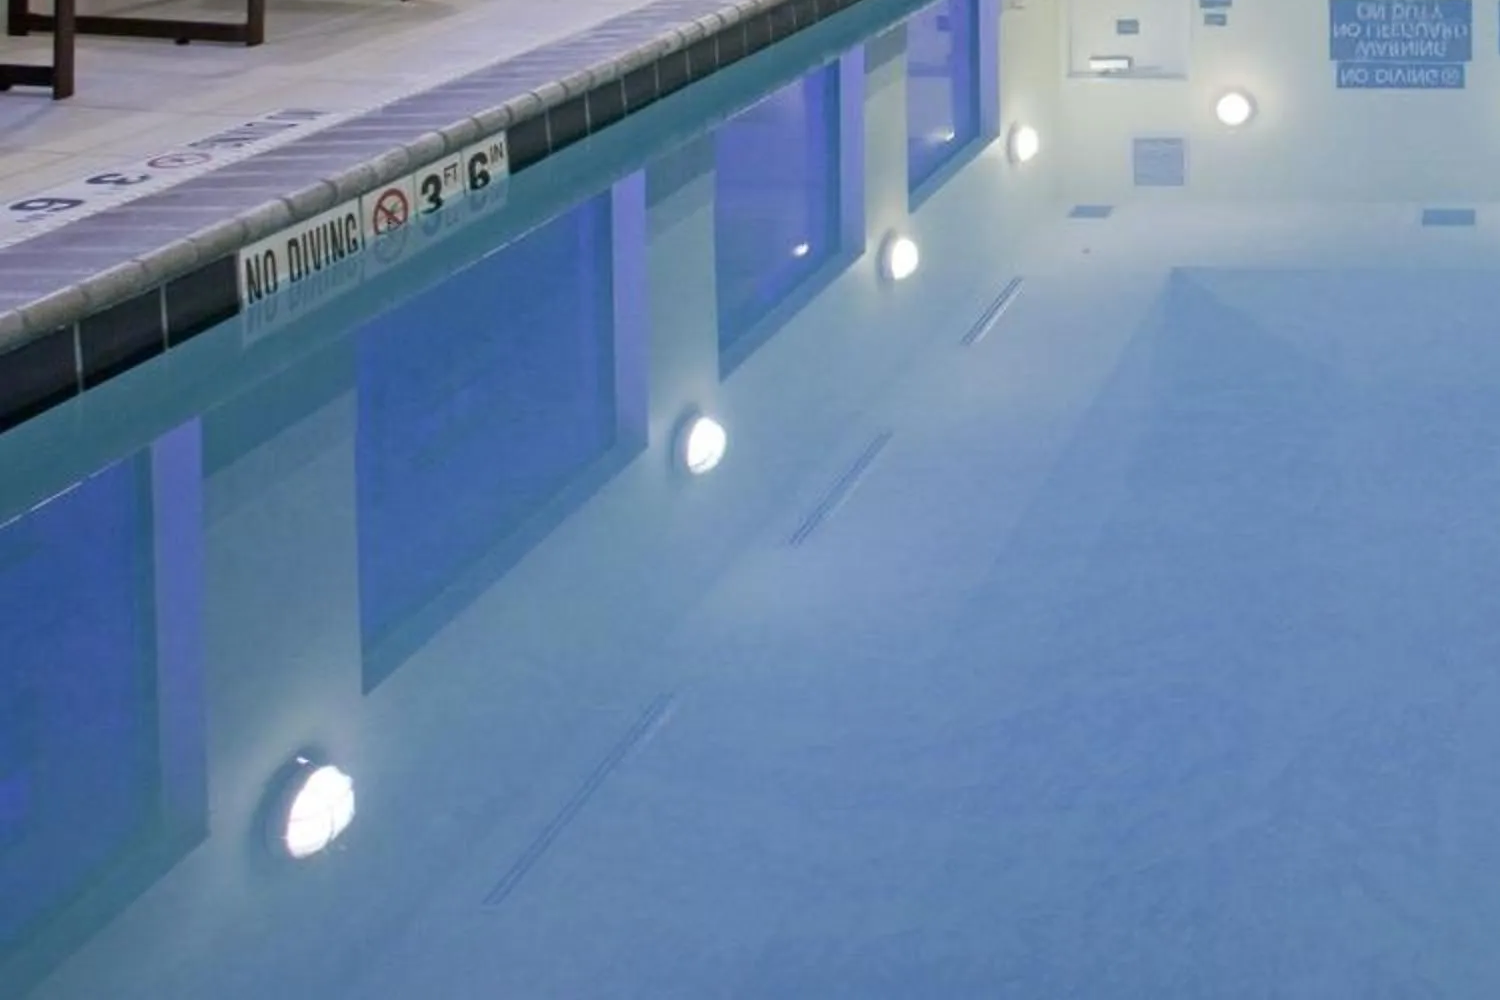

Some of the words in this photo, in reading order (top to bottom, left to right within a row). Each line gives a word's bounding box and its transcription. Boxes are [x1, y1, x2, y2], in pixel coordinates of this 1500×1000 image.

[245, 249, 279, 305] NO
[287, 212, 358, 283] DIVING
[421, 174, 443, 214] 3
[443, 163, 459, 184] FT
[468, 152, 490, 190] 6
[490, 142, 504, 161] IN
